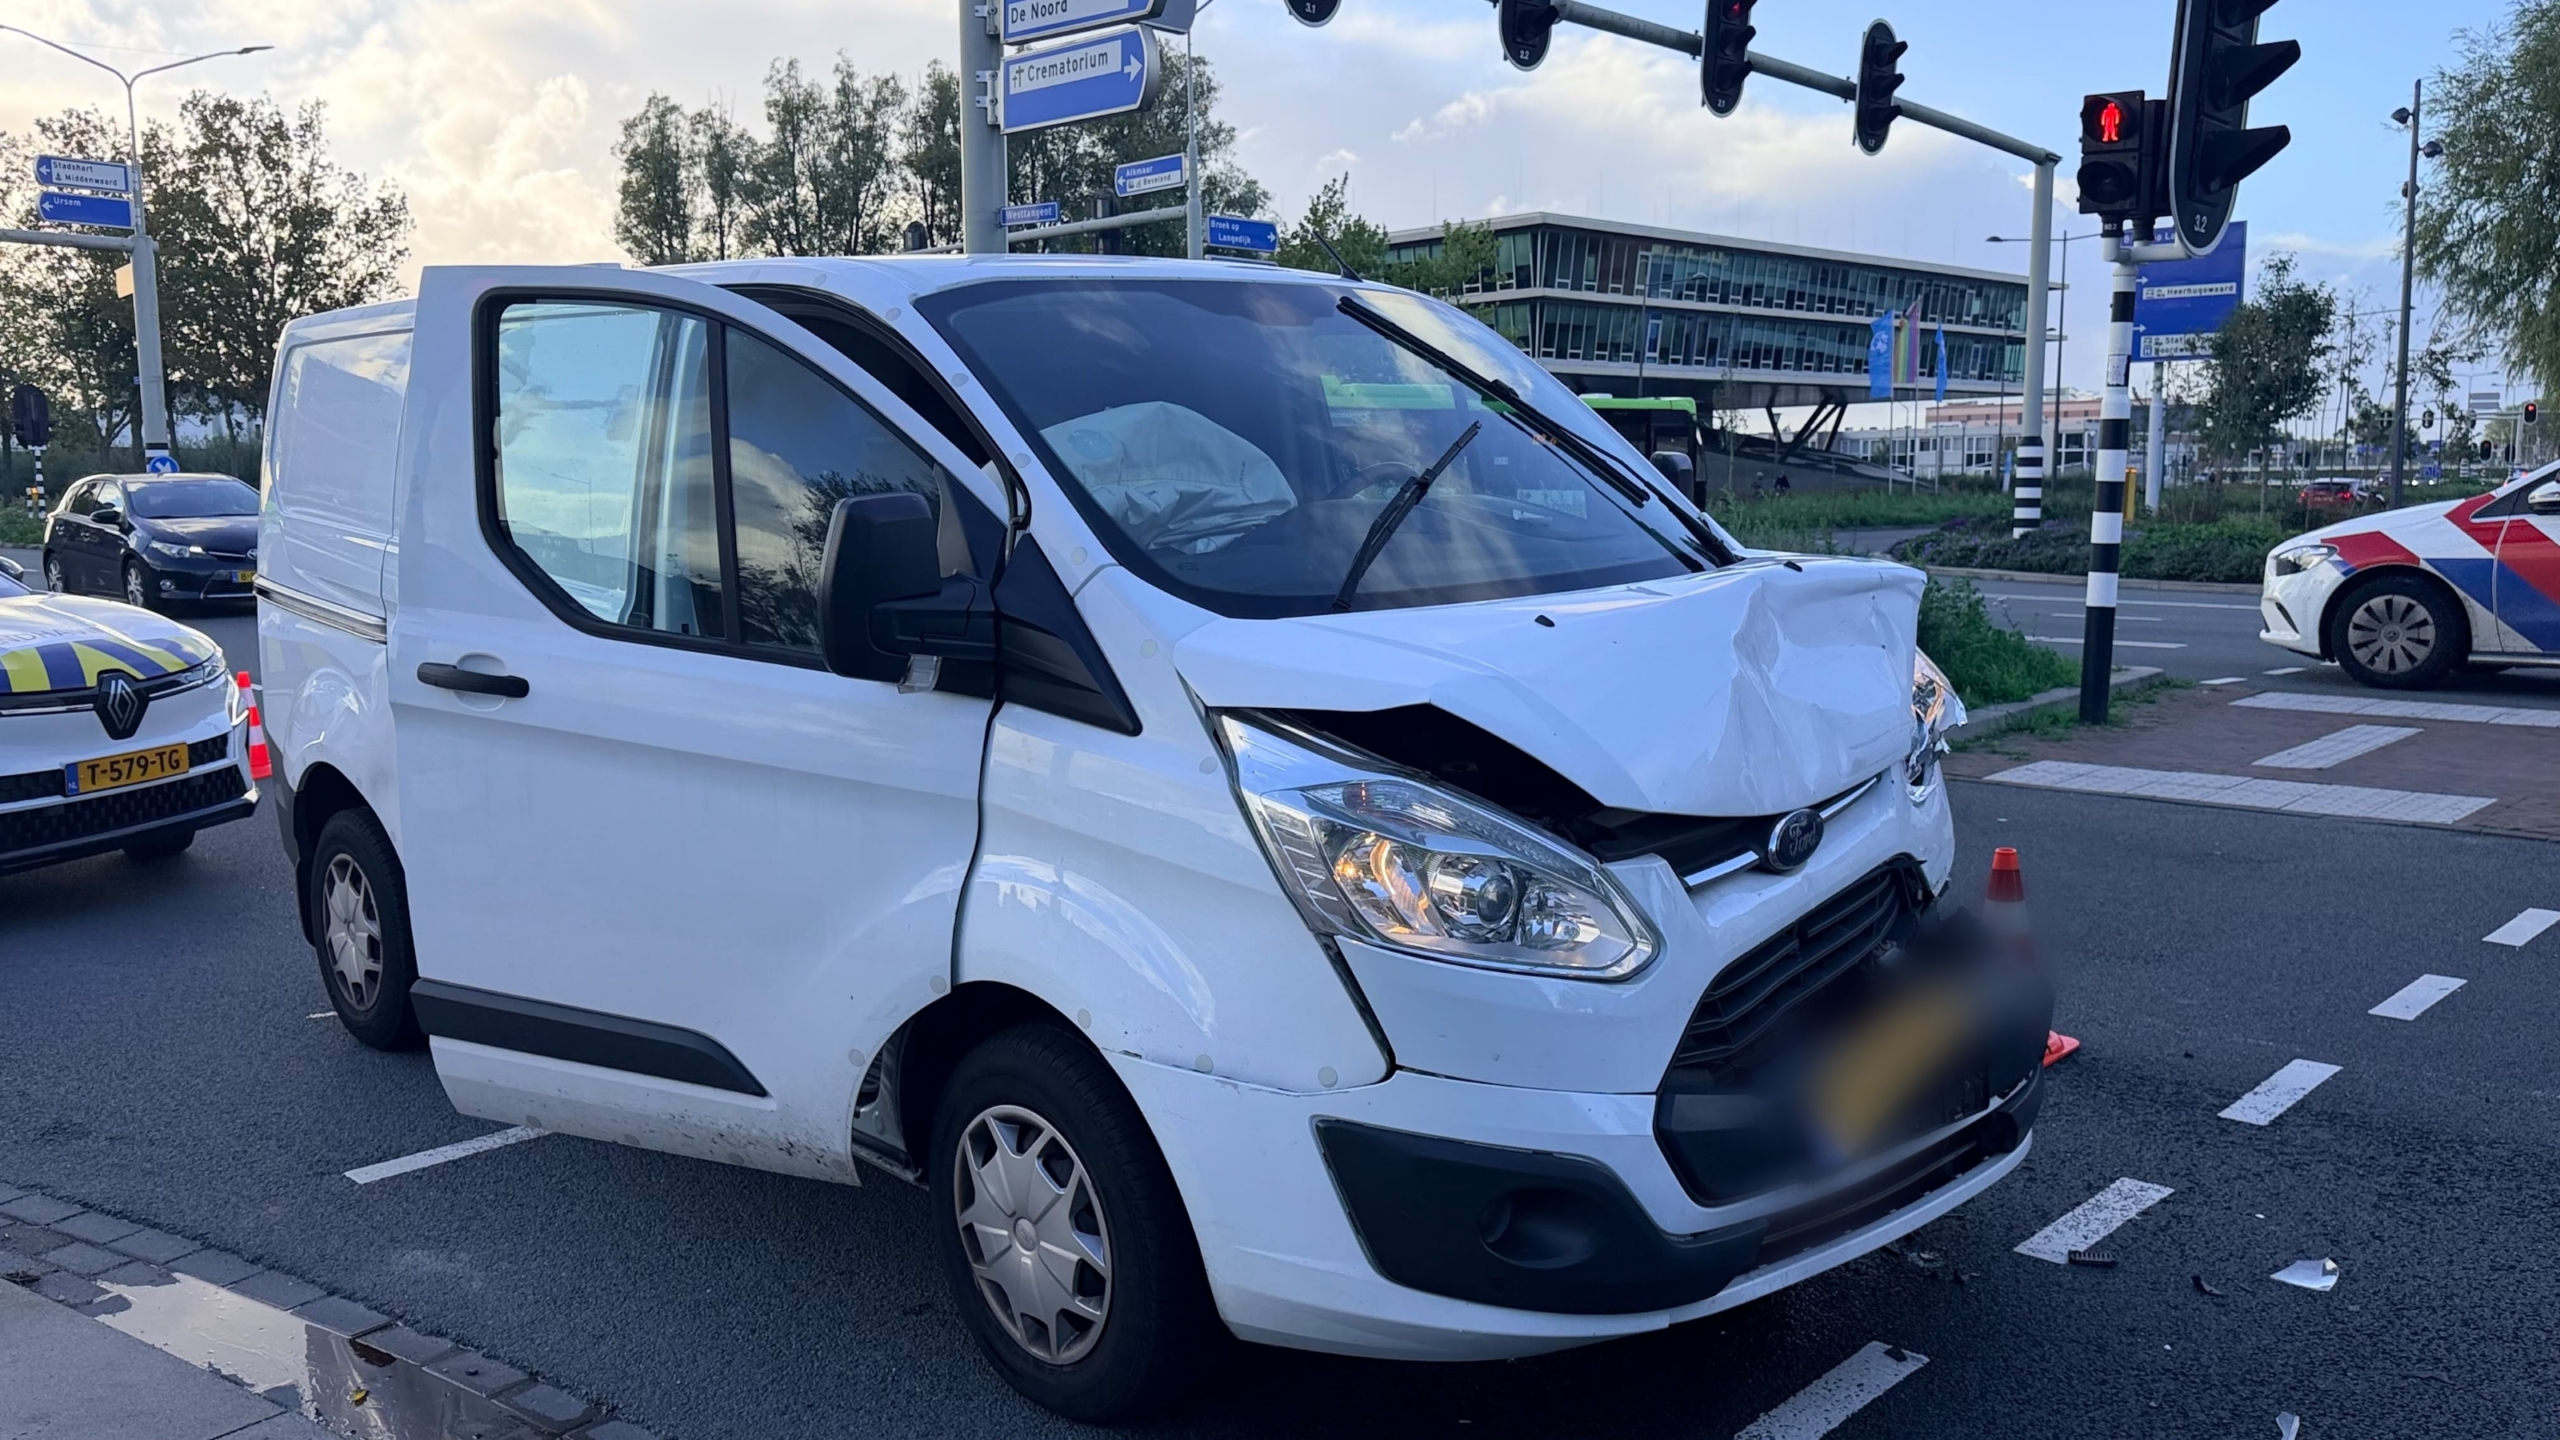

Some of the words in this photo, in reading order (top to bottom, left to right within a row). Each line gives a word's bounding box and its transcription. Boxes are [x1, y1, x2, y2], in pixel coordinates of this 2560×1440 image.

[1011, 7, 1026, 25] De
[1031, 0, 1068, 20] Noord
[1027, 52, 1108, 82] Crematorium
[52, 161, 94, 173] Stadshart
[1125, 165, 1154, 178] Alkmaar
[64, 173, 118, 187] Middenwaard
[53, 196, 81, 207] Ursem
[1006, 206, 1053, 220] Westtangent
[1210, 219, 1230, 230] Broek
[1231, 223, 1240, 232] op
[2194, 214, 2208, 233] 3.2
[1218, 232, 1251, 246] Langedijk
[2167, 284, 2234, 298] Heerhugowaard
[68, 781, 78, 790] NL
[86, 749, 181, 786] T-579-TG
[1789, 821, 1817, 858] Ford
